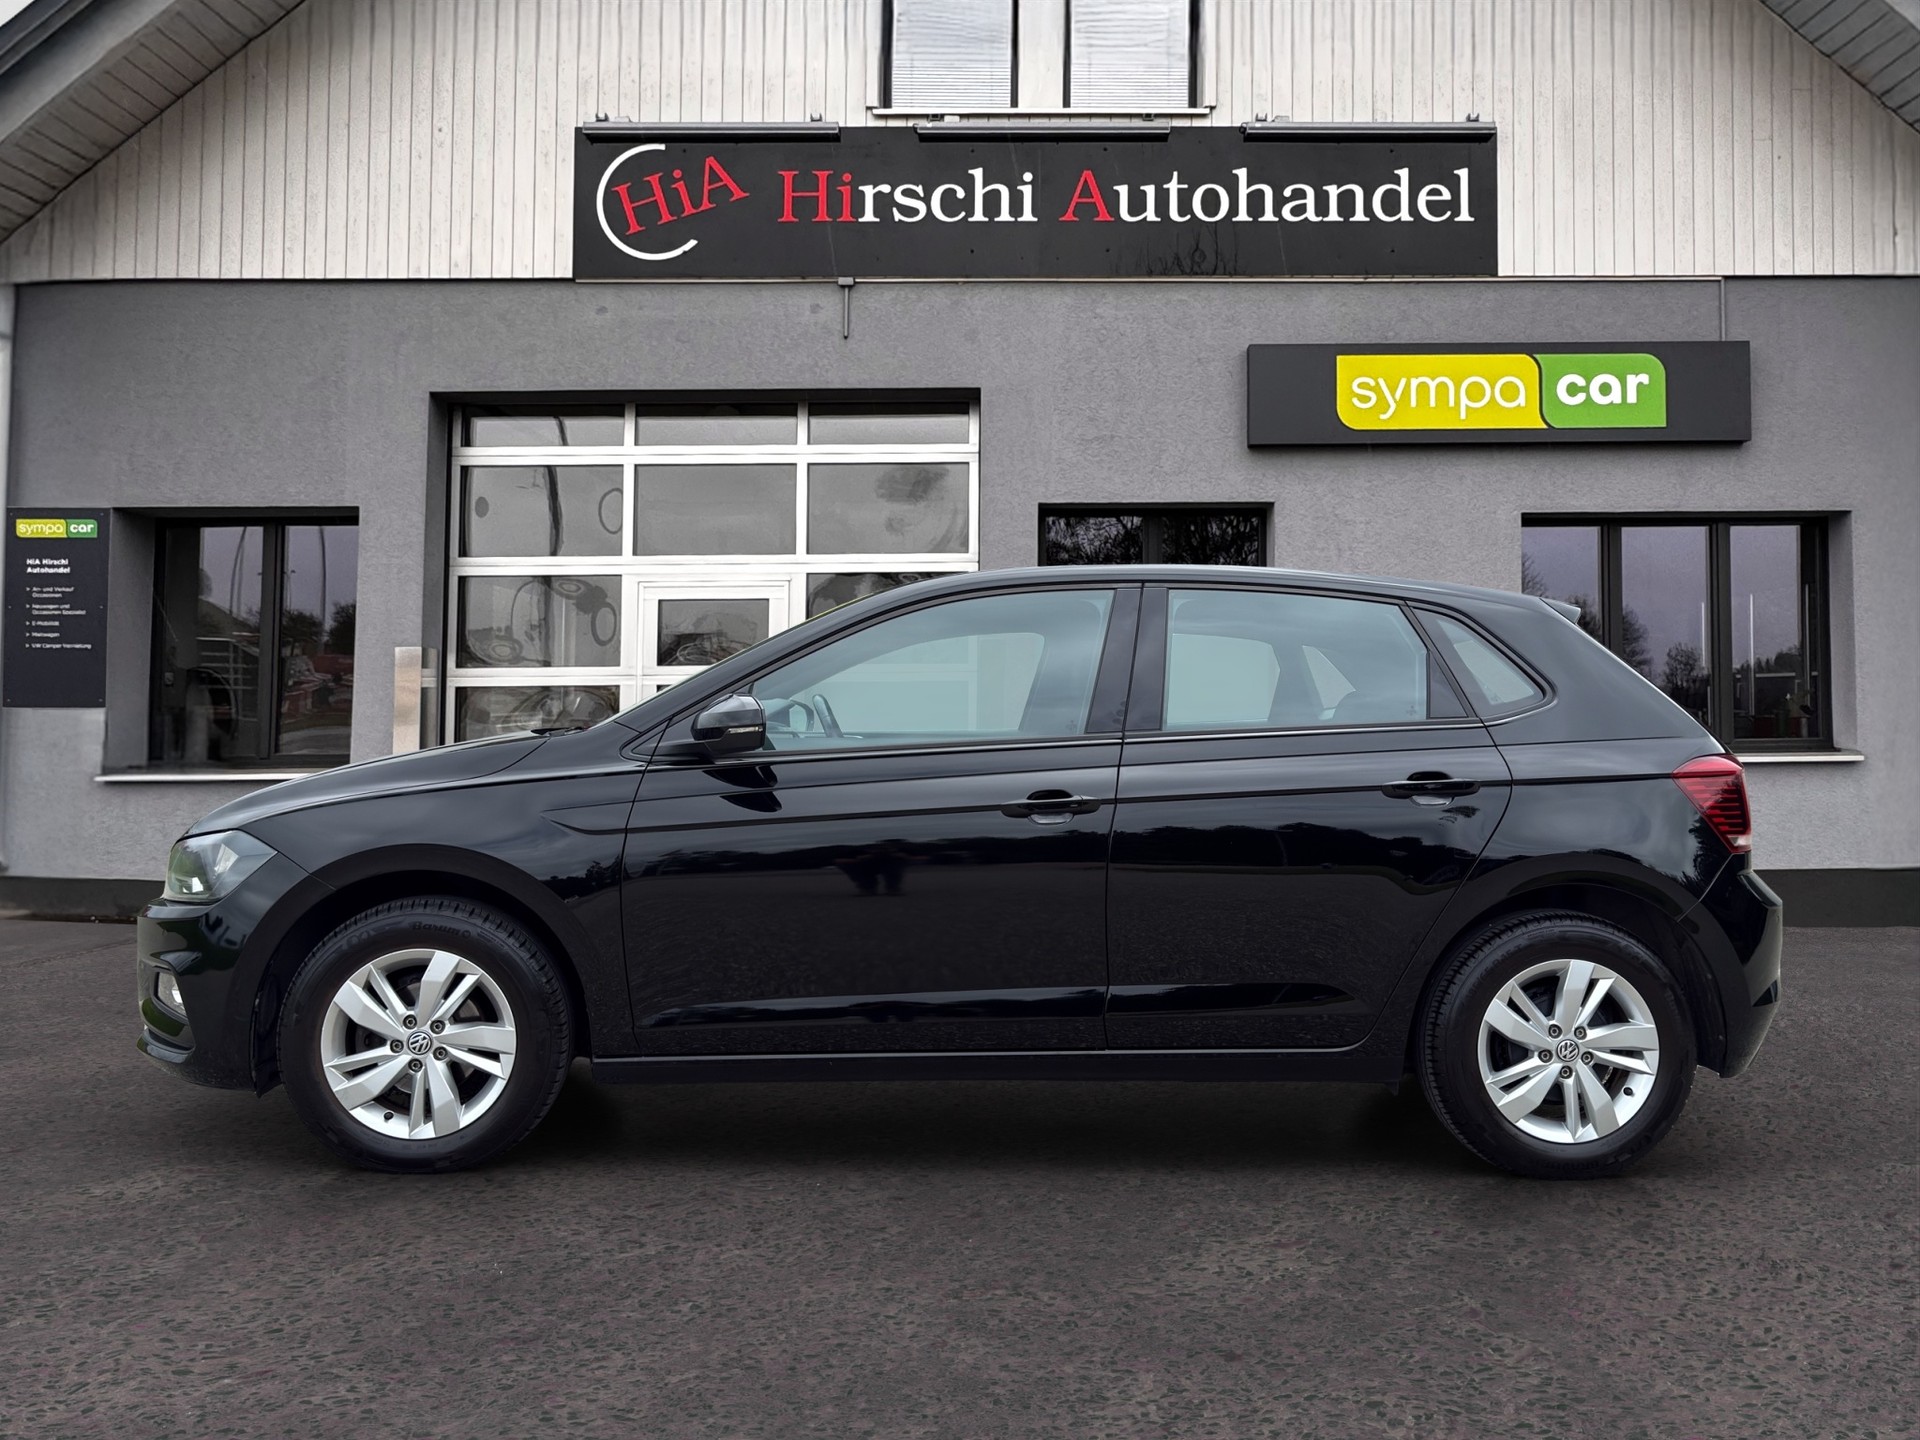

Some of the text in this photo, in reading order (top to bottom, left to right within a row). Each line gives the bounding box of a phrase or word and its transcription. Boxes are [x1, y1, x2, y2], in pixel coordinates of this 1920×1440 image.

[611, 156, 750, 236] HiA
[777, 167, 1476, 223] Hirschi Autohandel
[1351, 373, 1650, 420] sympa car
[19, 523, 95, 535] sympa car
